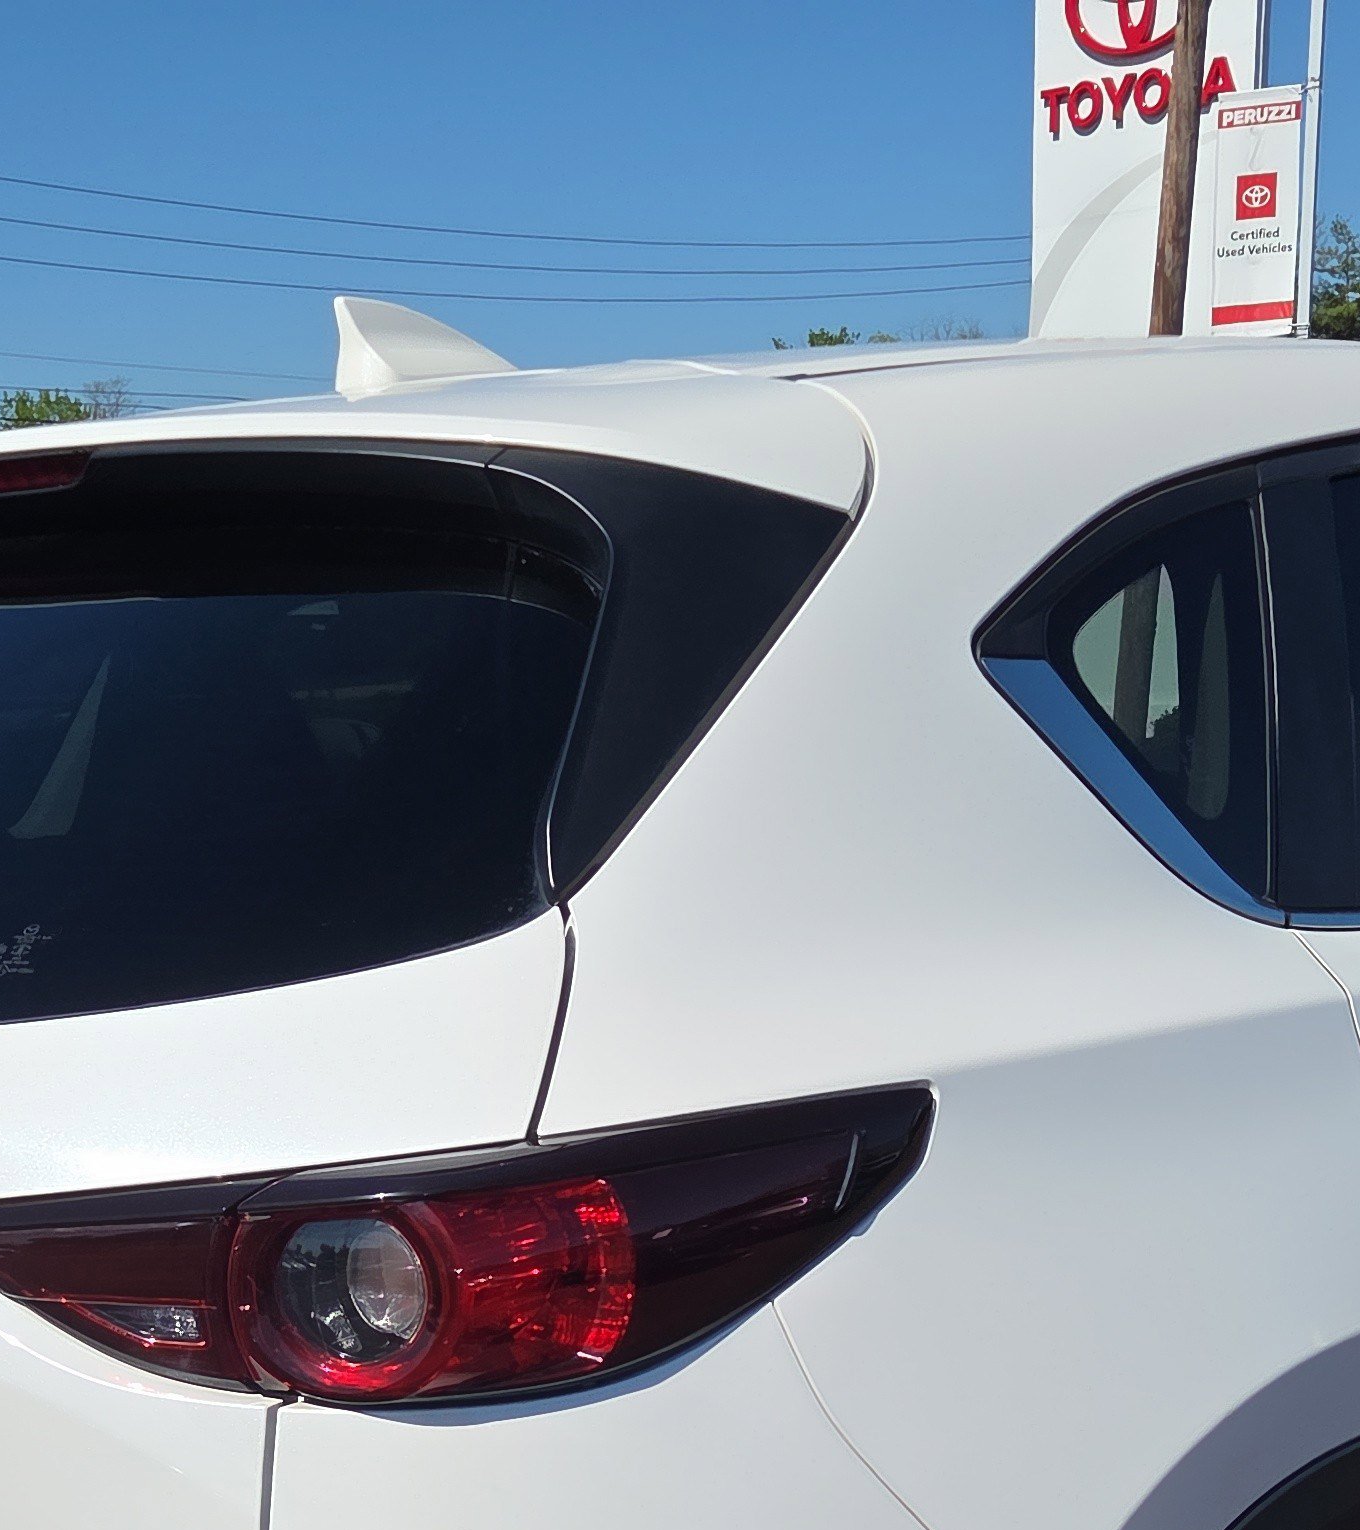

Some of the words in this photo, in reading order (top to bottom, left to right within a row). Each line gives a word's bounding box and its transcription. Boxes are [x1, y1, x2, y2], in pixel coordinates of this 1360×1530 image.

[1041, 56, 1237, 137] TOYOA
[1222, 104, 1297, 127] PERUZZI
[1230, 226, 1280, 242] Certified
[1217, 245, 1245, 258] Used
[1248, 242, 1293, 256] Vehicles
